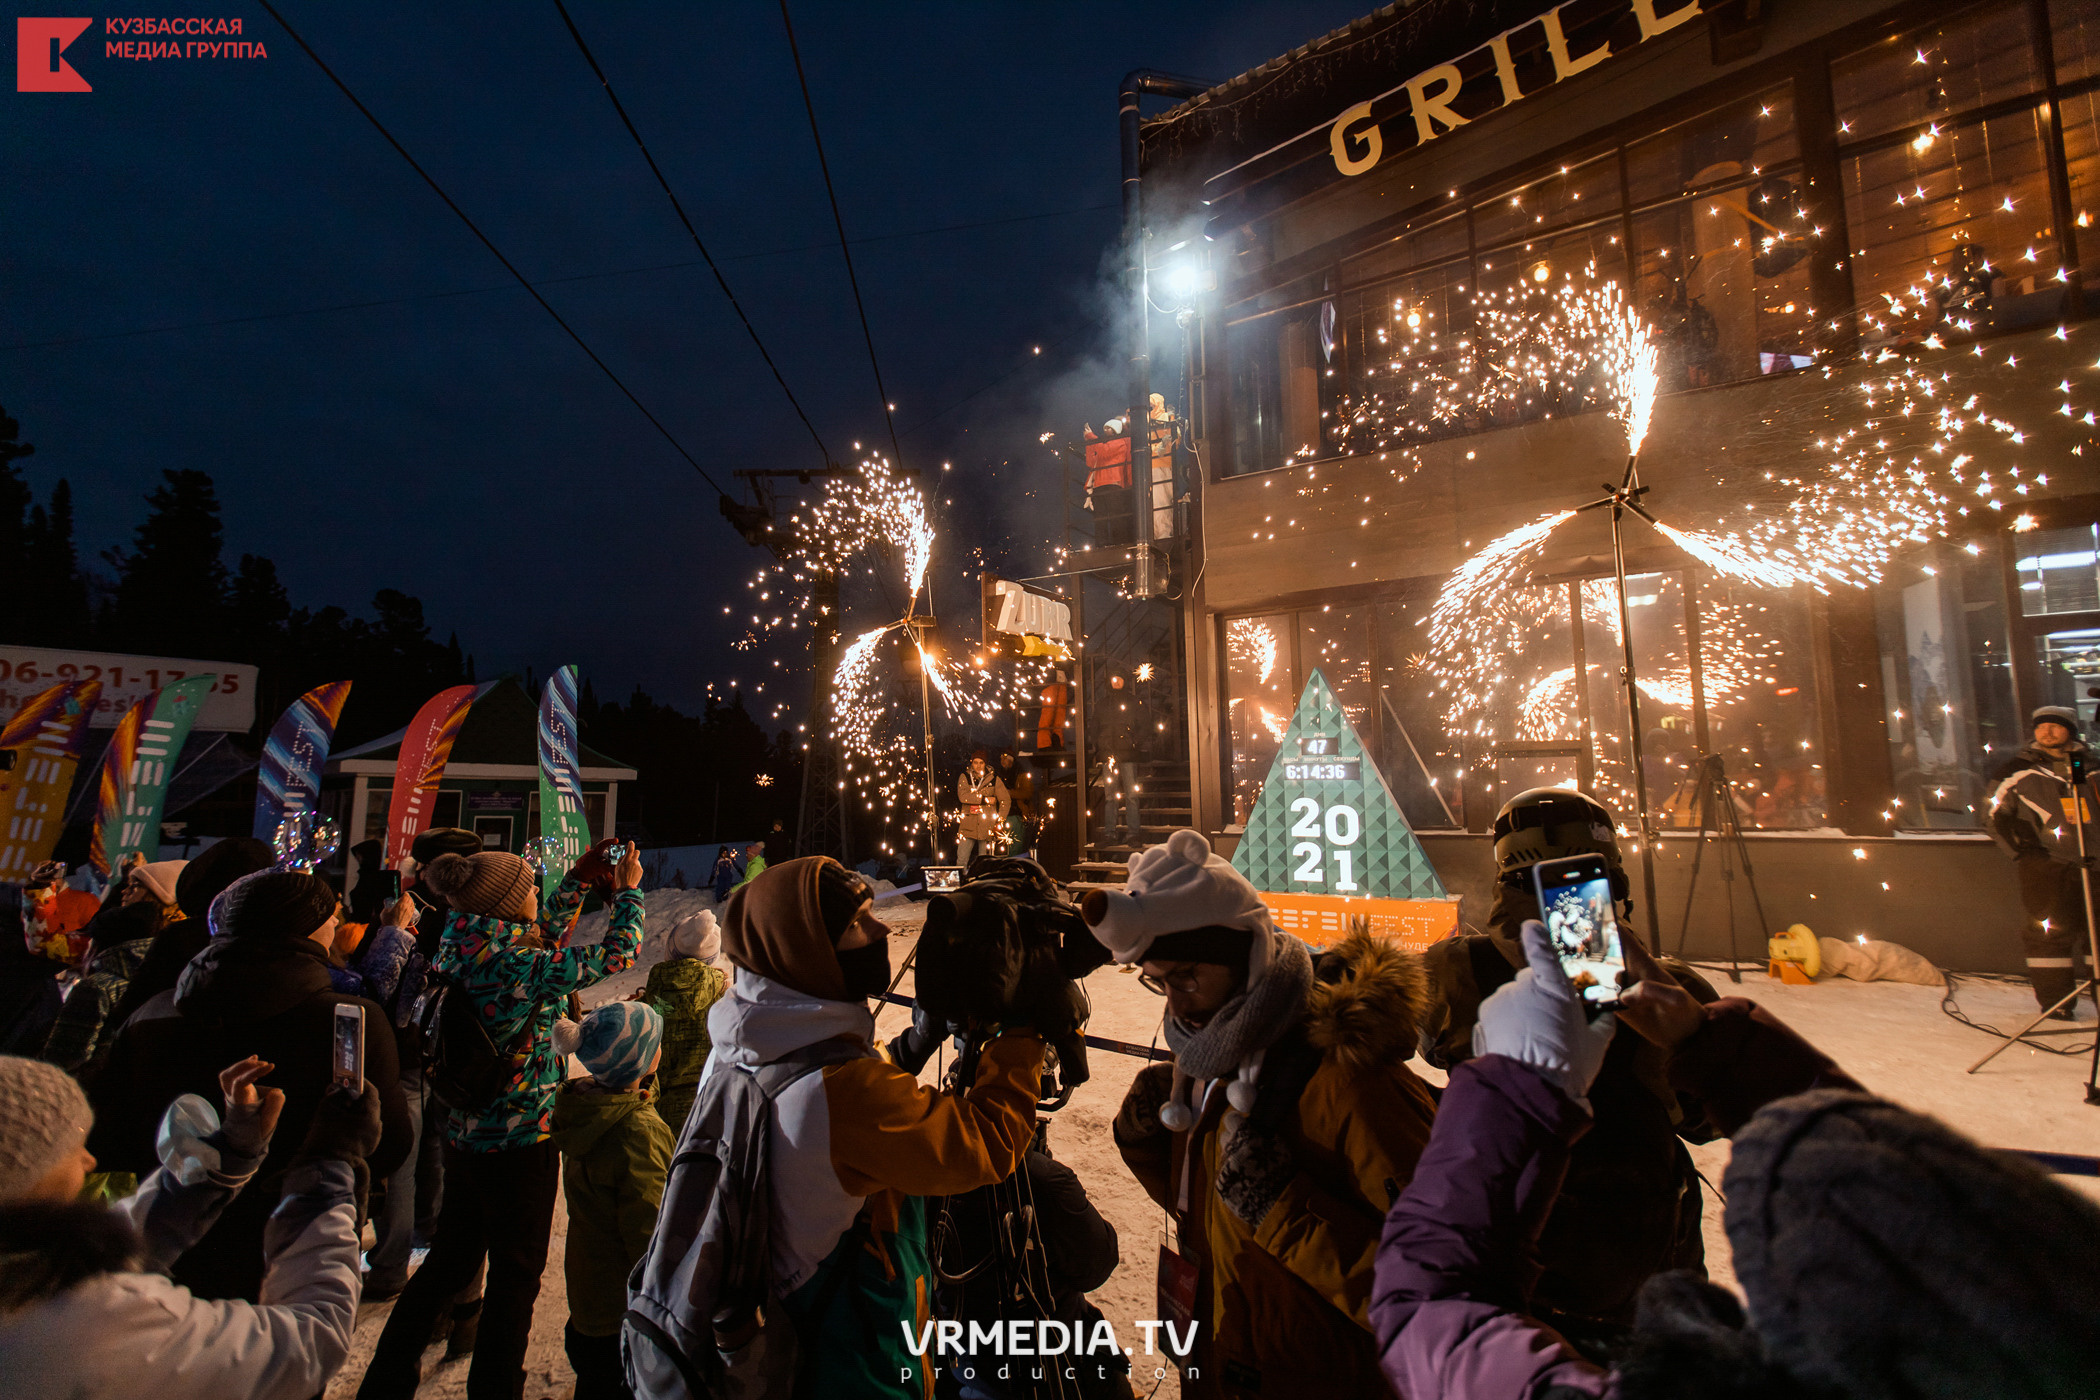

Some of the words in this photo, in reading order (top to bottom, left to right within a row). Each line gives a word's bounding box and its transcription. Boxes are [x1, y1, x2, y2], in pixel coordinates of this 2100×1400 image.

[1329, 0, 1703, 177] GRILL
[995, 579, 1074, 641] ZUBR
[1286, 764, 1346, 780] 6:14:36
[1307, 739, 1327, 755] 47
[1290, 797, 1360, 847] 20
[1292, 841, 1358, 892] 21
